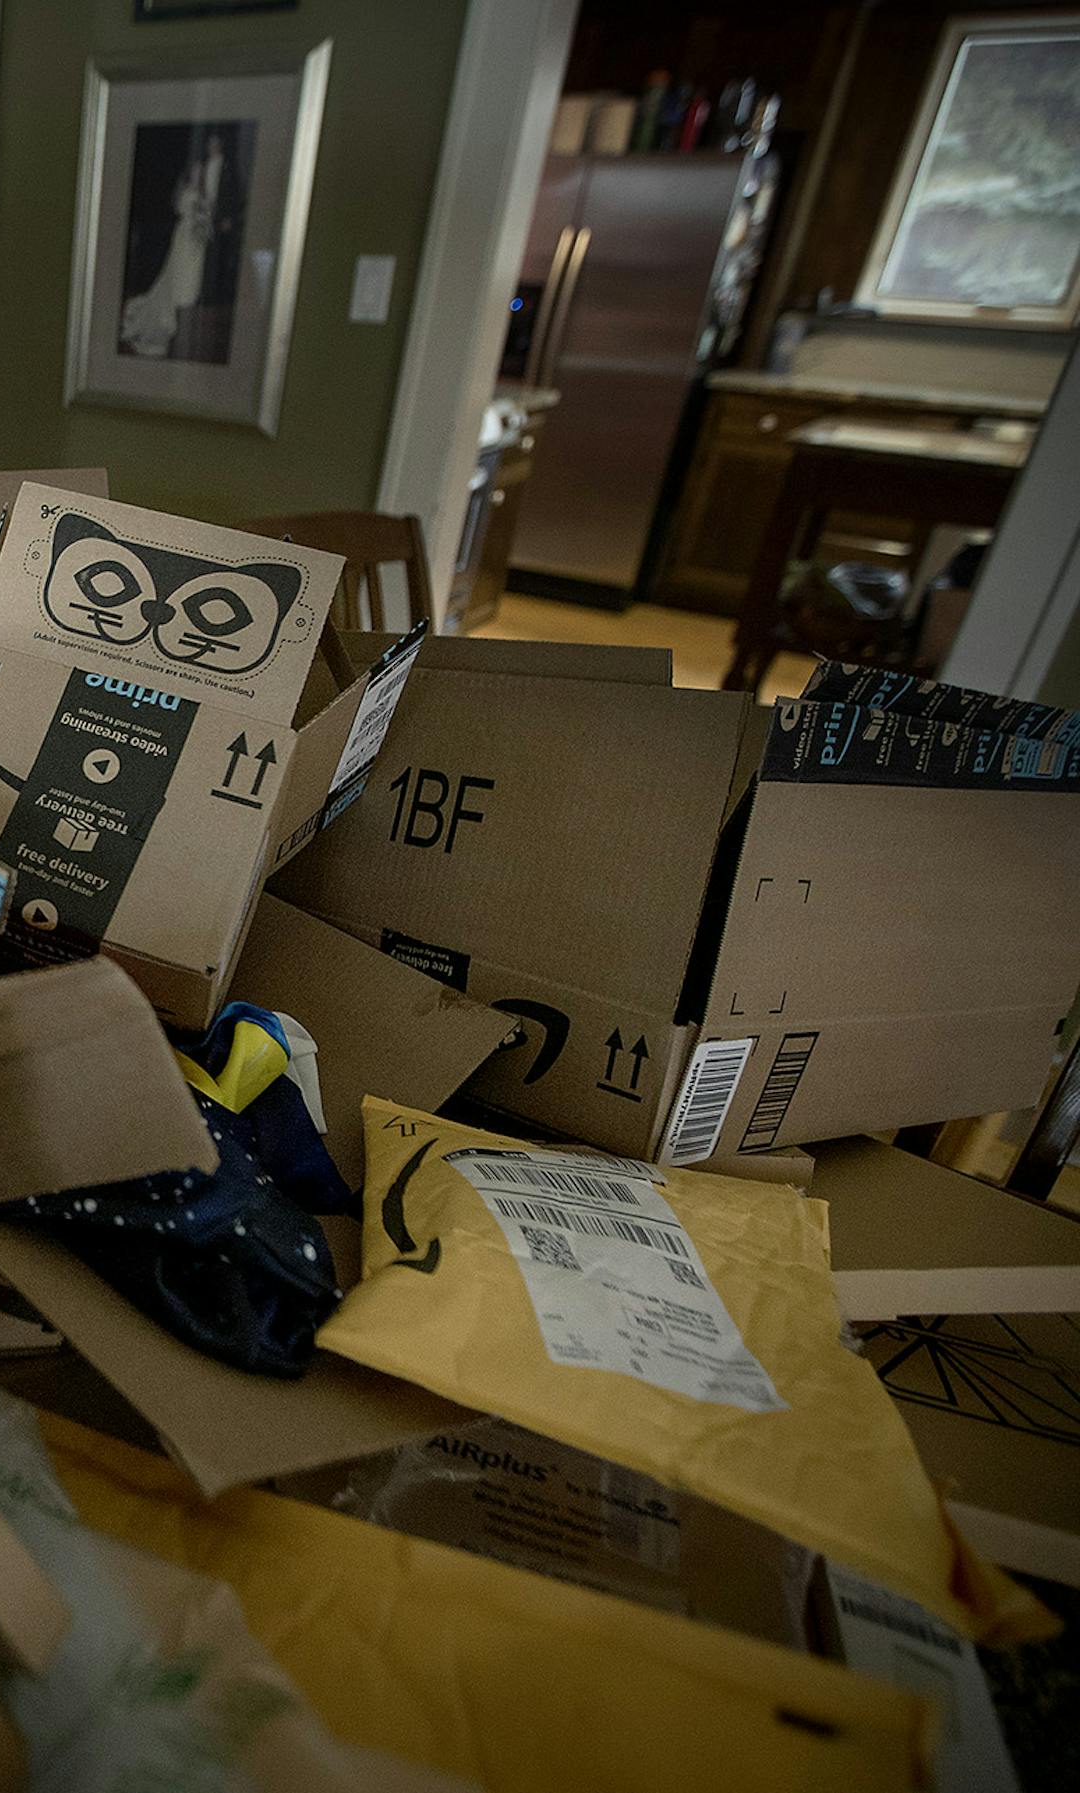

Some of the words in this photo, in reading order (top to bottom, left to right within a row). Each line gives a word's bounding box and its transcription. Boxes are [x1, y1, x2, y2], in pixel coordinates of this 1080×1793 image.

[84, 673, 181, 712] prime
[60, 711, 129, 745] streaming
[130, 736, 168, 758] video
[390, 766, 495, 854] 1BF
[17, 843, 47, 866] free
[49, 858, 110, 891] delivery
